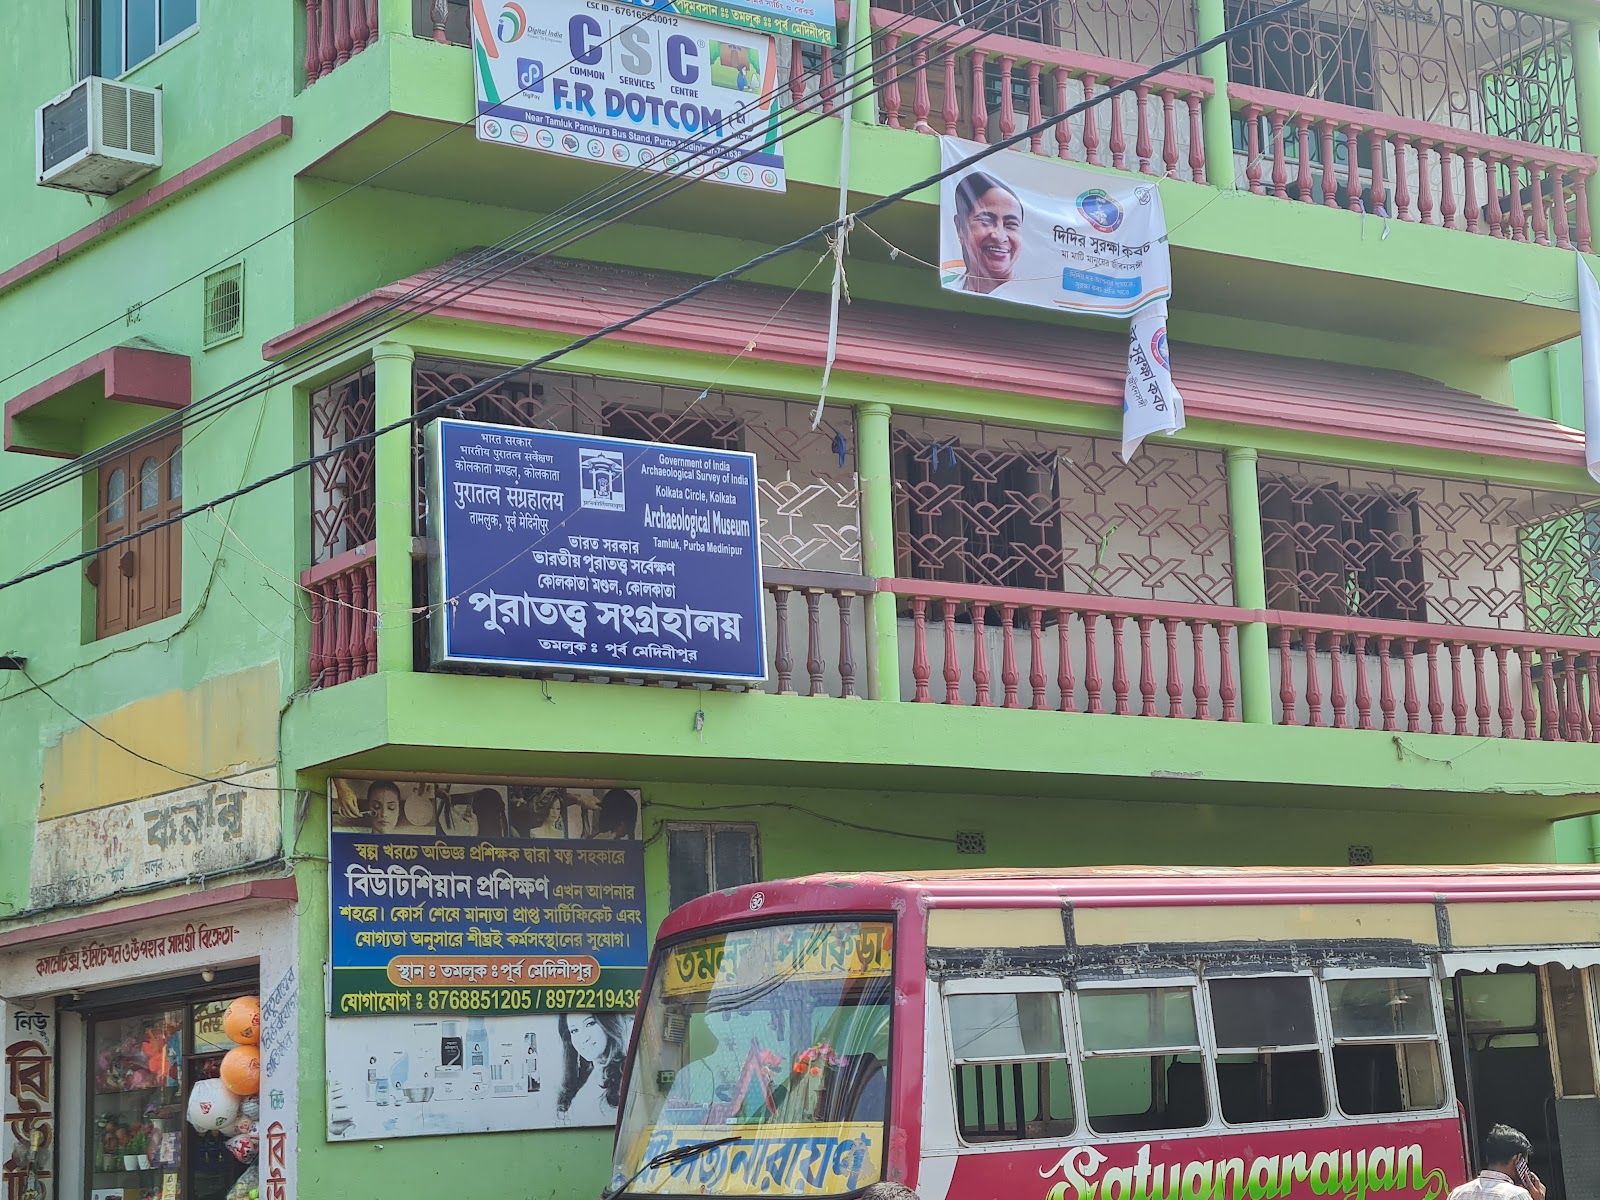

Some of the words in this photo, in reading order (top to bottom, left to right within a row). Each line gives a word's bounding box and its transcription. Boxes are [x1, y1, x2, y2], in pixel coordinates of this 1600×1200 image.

[587, 1, 600, 11] CSC
[602, 4, 609, 12] ID
[527, 25, 548, 36] Digital
[548, 30, 563, 39] India
[731, 9, 761, 27] তমলুক
[774, 18, 789, 34] পূর্ব
[791, 22, 831, 44] মেদিনীপুর
[570, 66, 605, 80] COMMON
[619, 75, 656, 90] SERVICES
[670, 86, 699, 98] CENTRE
[522, 91, 541, 101] DigiPay
[553, 77, 596, 118] F.R
[604, 87, 723, 138] DOTCOM
[525, 112, 543, 123] Near
[545, 116, 573, 129] Tamluk
[575, 122, 610, 137] Panskura
[612, 128, 627, 139] Bus
[628, 131, 653, 145] Stand,
[654, 136, 676, 147] Purba
[1053, 225, 1086, 248] দিদির
[1089, 236, 1120, 257] সুরক্ষা
[1061, 250, 1069, 259] মা
[1071, 250, 1084, 261] মাটি
[1147, 380, 1168, 412] কবচ
[481, 433, 502, 445] भारत
[504, 435, 532, 448] सरकार
[460, 444, 490, 458] भारतीय
[492, 449, 522, 462] पुरातत्व
[524, 450, 553, 464] सर्वेक्षण
[658, 453, 702, 468] Government
[704, 459, 712, 470] of
[712, 460, 731, 472] India
[454, 456, 492, 473] कोलकाता
[494, 464, 521, 480] मण्डल,
[523, 464, 560, 481] कोलकाता
[641, 463, 695, 481] Archaeological
[695, 470, 721, 485] Survey
[722, 473, 730, 483] of
[731, 474, 749, 486] India
[453, 481, 501, 510] पुरातत्व
[505, 479, 565, 512] संग्रहालय
[655, 485, 683, 499] Kolkata
[684, 488, 708, 504] Circle,
[709, 490, 737, 505] Kolkata
[468, 511, 502, 531] तामलुक,
[504, 511, 517, 533] पूर्व
[518, 512, 550, 535] मेदिनीपुर
[644, 503, 710, 539] Archaeological
[712, 510, 750, 537] Museum
[568, 535, 599, 551] ভারত
[602, 539, 640, 555] সরকার
[653, 537, 682, 552] Tamluk,
[683, 539, 705, 552] Purba
[706, 541, 743, 557] Medinipur
[532, 548, 581, 569] ভারতীয়
[630, 555, 675, 577] সর্বেক্ষণ
[537, 573, 590, 593] কোলকাতা
[591, 578, 623, 597] মণ্ডল,
[625, 580, 676, 600] কোলকাতা
[592, 602, 743, 643] সংগ্রহালয়
[538, 638, 588, 657] তমলুক
[604, 640, 629, 659] পূর্ব
[632, 643, 699, 664] মেদিনীপুর
[353, 843, 379, 861] স্বল্প
[382, 842, 419, 860] খরচে
[420, 840, 466, 862] অভিজ্ঞ
[469, 841, 521, 863] প্রশিক্ষক
[522, 846, 551, 864] দ্বারা
[553, 848, 574, 866] যত্ন
[576, 848, 626, 866] সহকারে
[343, 863, 473, 900] বিউটিশিয়ান
[476, 868, 551, 900] প্রশিক্ষণ
[552, 883, 584, 900] এখন
[585, 884, 637, 901] আপনার
[390, 901, 427, 923] কোর্স
[429, 905, 461, 923] শেষে
[463, 905, 509, 924] মান্যতা
[512, 906, 541, 925] প্রাপ্ত
[543, 903, 613, 924] সার্টিফিকেট
[616, 909, 643, 925] এবং
[355, 930, 407, 948] যোগ্যতা
[410, 930, 464, 952] অনুসারে
[466, 926, 504, 950] শীঘ্রই
[505, 926, 583, 952] কর্মসংস্থানের
[586, 931, 631, 951] সুযোগ।
[395, 962, 425, 983] স্থান
[439, 964, 488, 983] তমলুক
[501, 958, 525, 983] পূর্ব
[527, 958, 593, 983] মেদিনীপুর
[340, 989, 412, 1013] যোগাযোগ
[428, 989, 532, 1010] 8768851205
[546, 988, 642, 1009] 8972219436
[14, 1011, 51, 1036] নিউ
[1039, 1143, 1447, 1200] Satyanarayan
